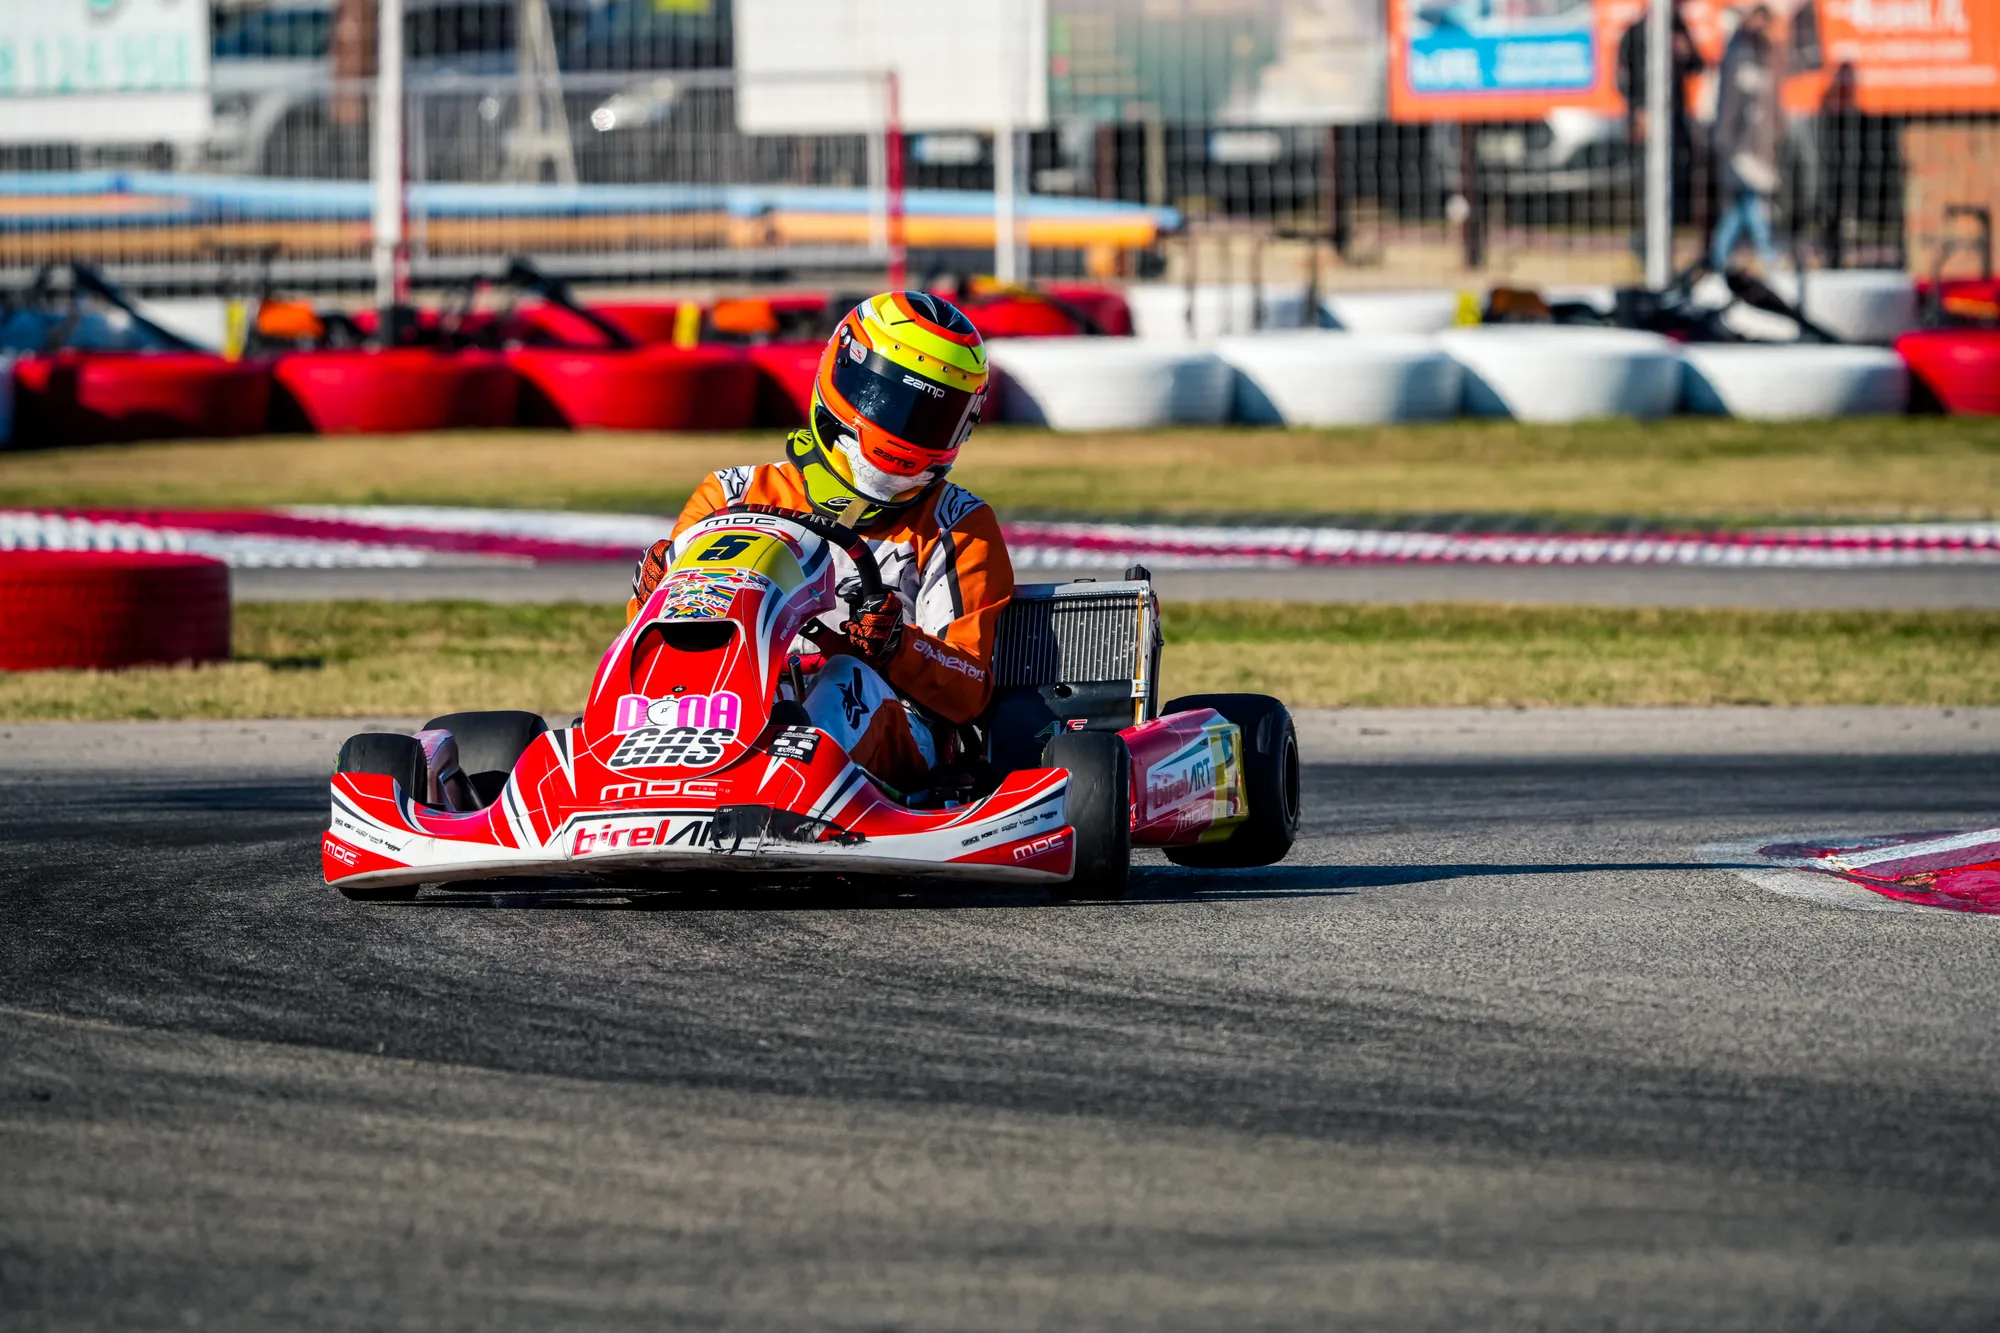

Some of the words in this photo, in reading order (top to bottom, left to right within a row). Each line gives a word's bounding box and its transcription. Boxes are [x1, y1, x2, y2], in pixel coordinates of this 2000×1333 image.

[903, 375, 946, 399] zamp
[872, 447, 916, 470] zamp
[697, 535, 761, 561] 5
[610, 727, 735, 768] GAS
